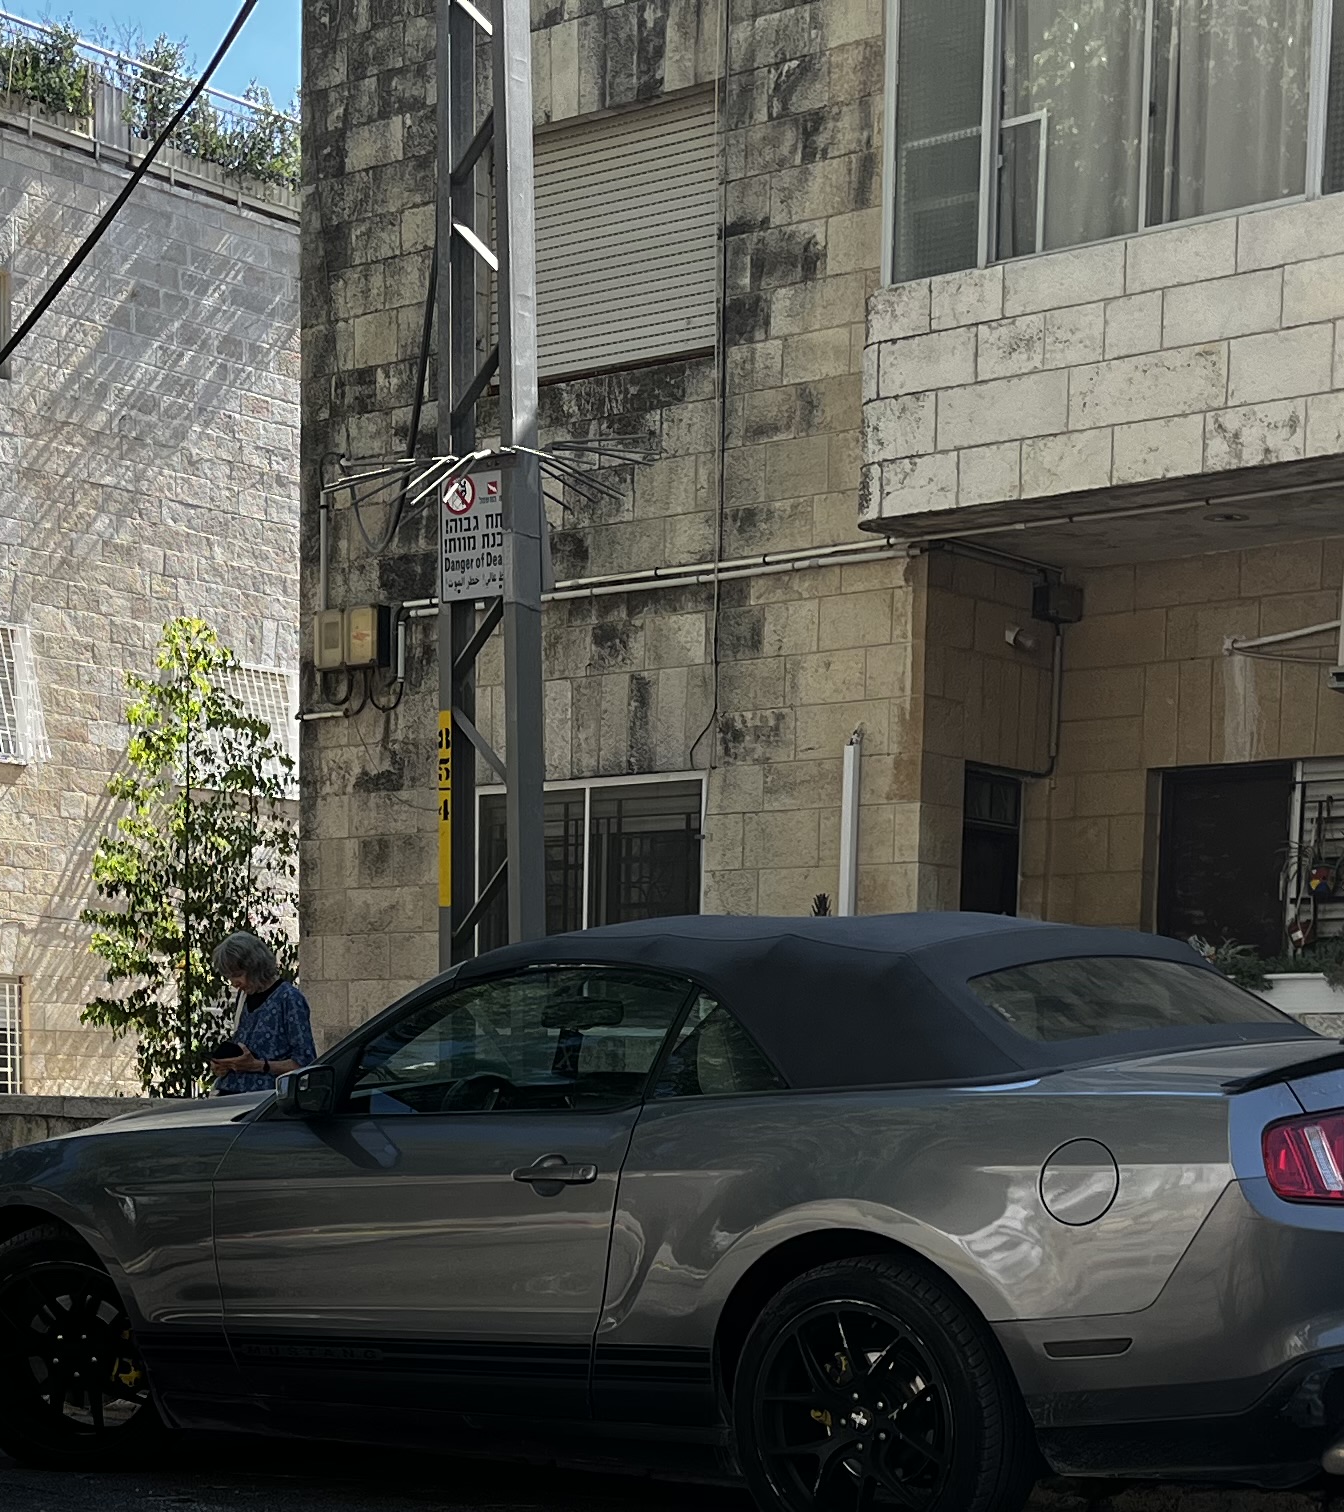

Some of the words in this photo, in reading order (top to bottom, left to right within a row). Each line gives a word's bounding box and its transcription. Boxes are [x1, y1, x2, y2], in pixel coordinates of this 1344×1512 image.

[445, 516, 479, 534] גבוה!
[485, 513, 502, 529] תח
[444, 535, 476, 554] מוות!
[482, 532, 503, 549] כנת
[444, 557, 474, 574] Danger
[475, 553, 485, 568] of
[486, 552, 502, 567] Dea
